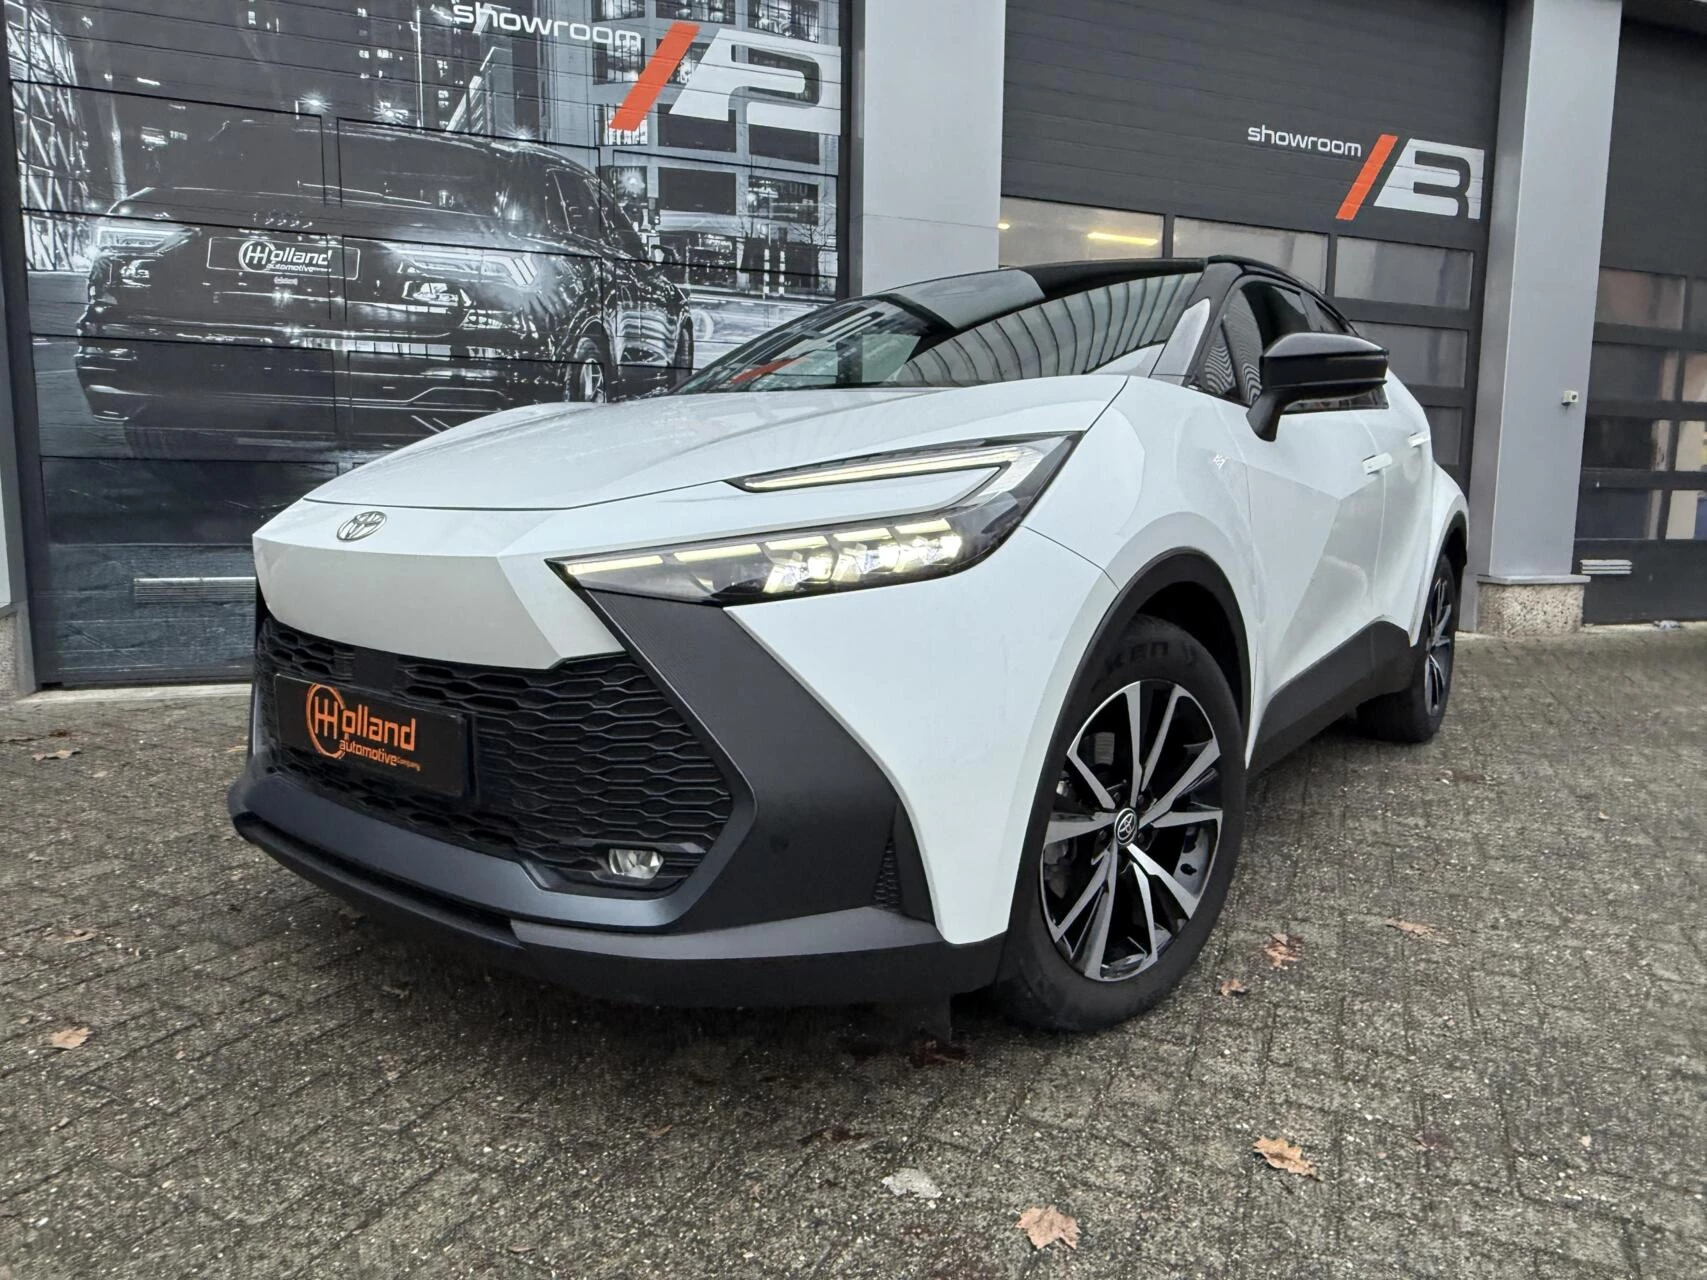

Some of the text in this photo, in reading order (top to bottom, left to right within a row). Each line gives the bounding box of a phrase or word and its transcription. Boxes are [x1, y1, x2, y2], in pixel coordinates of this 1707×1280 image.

[453, 2, 641, 47] showroom
[1247, 124, 1362, 157] showroom
[314, 695, 416, 751] Holland
[339, 738, 398, 766] automotive
